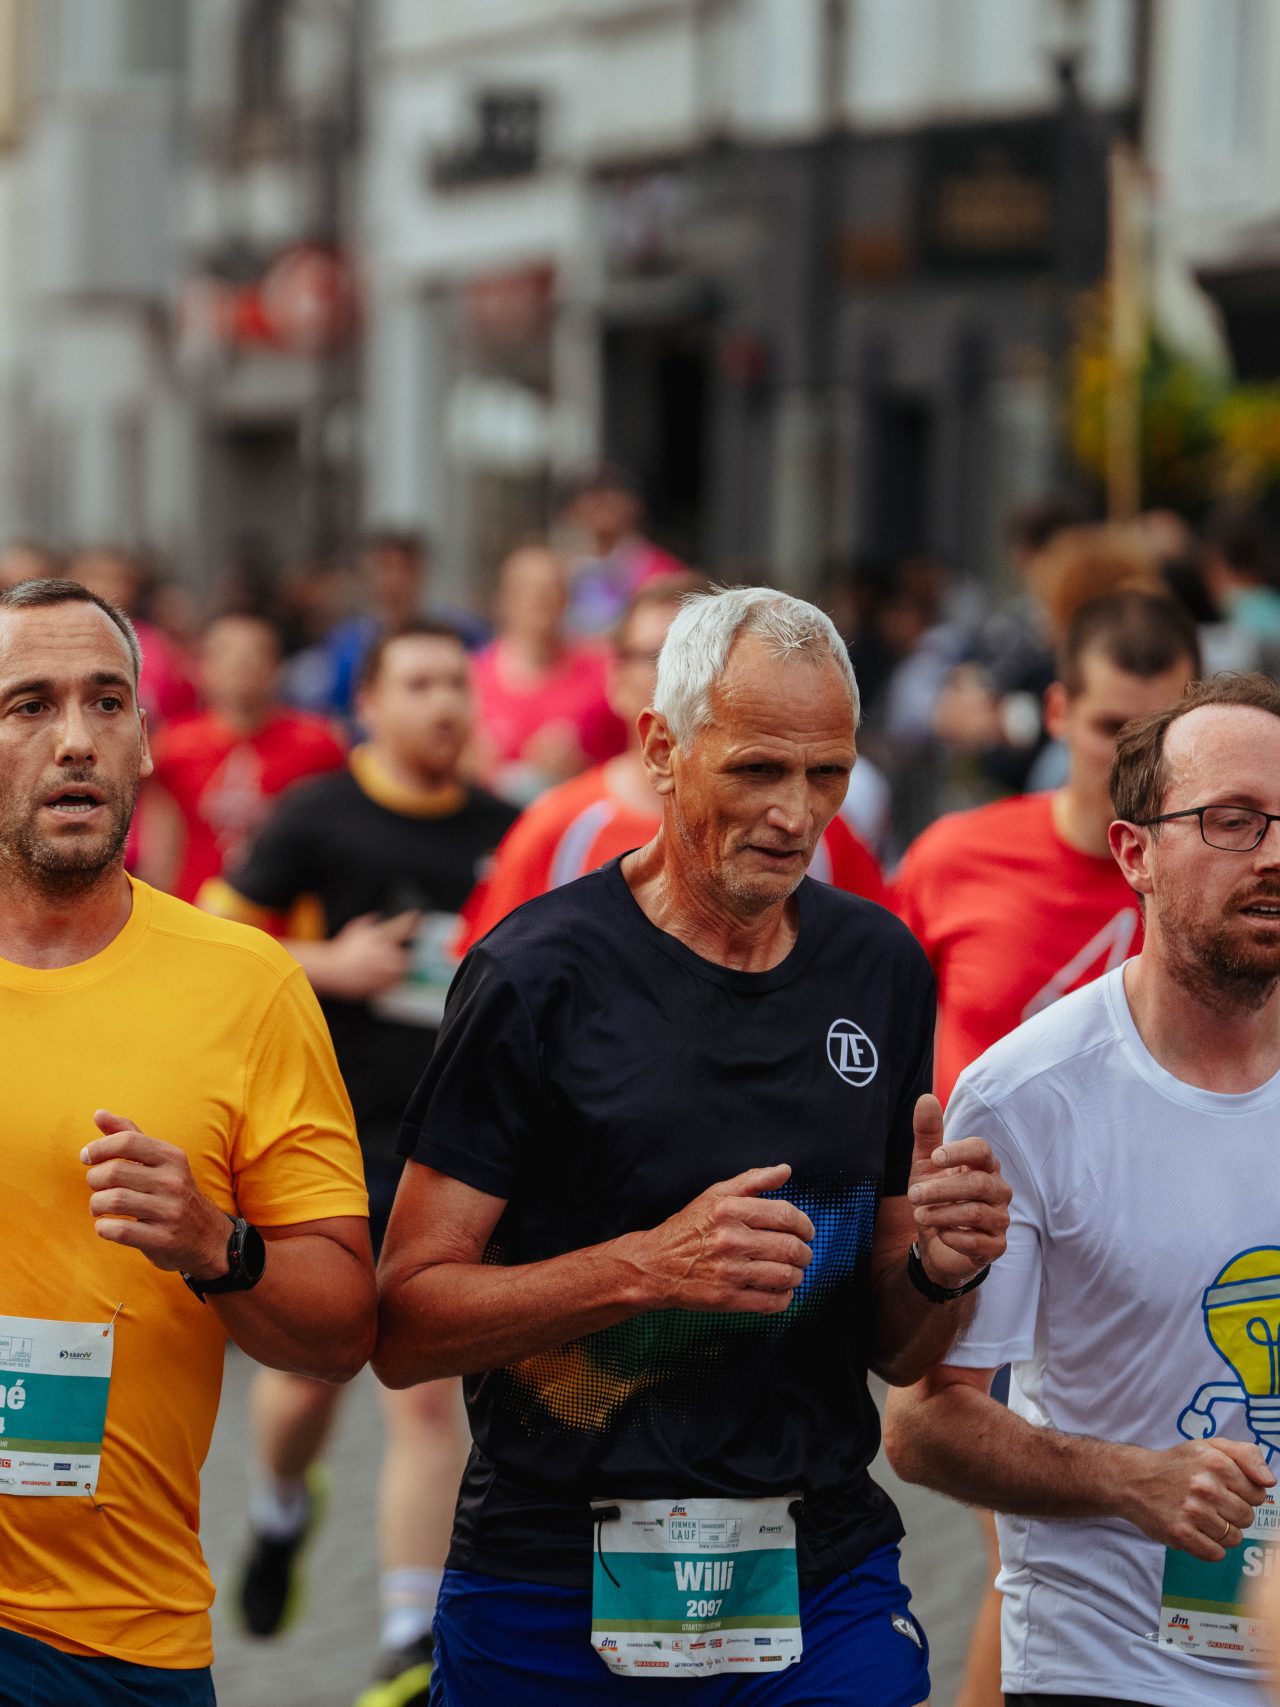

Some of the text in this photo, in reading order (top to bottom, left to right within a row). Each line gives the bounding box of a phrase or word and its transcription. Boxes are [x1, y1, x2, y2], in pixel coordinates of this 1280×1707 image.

[672, 1505, 685, 1513] dm
[1259, 1508, 1280, 1517] FIRME
[672, 1530, 696, 1540] LAUF
[673, 1560, 734, 1591] Willi
[686, 1599, 722, 1617] 2097
[1172, 1614, 1188, 1625] dm
[601, 1637, 617, 1647] dm
